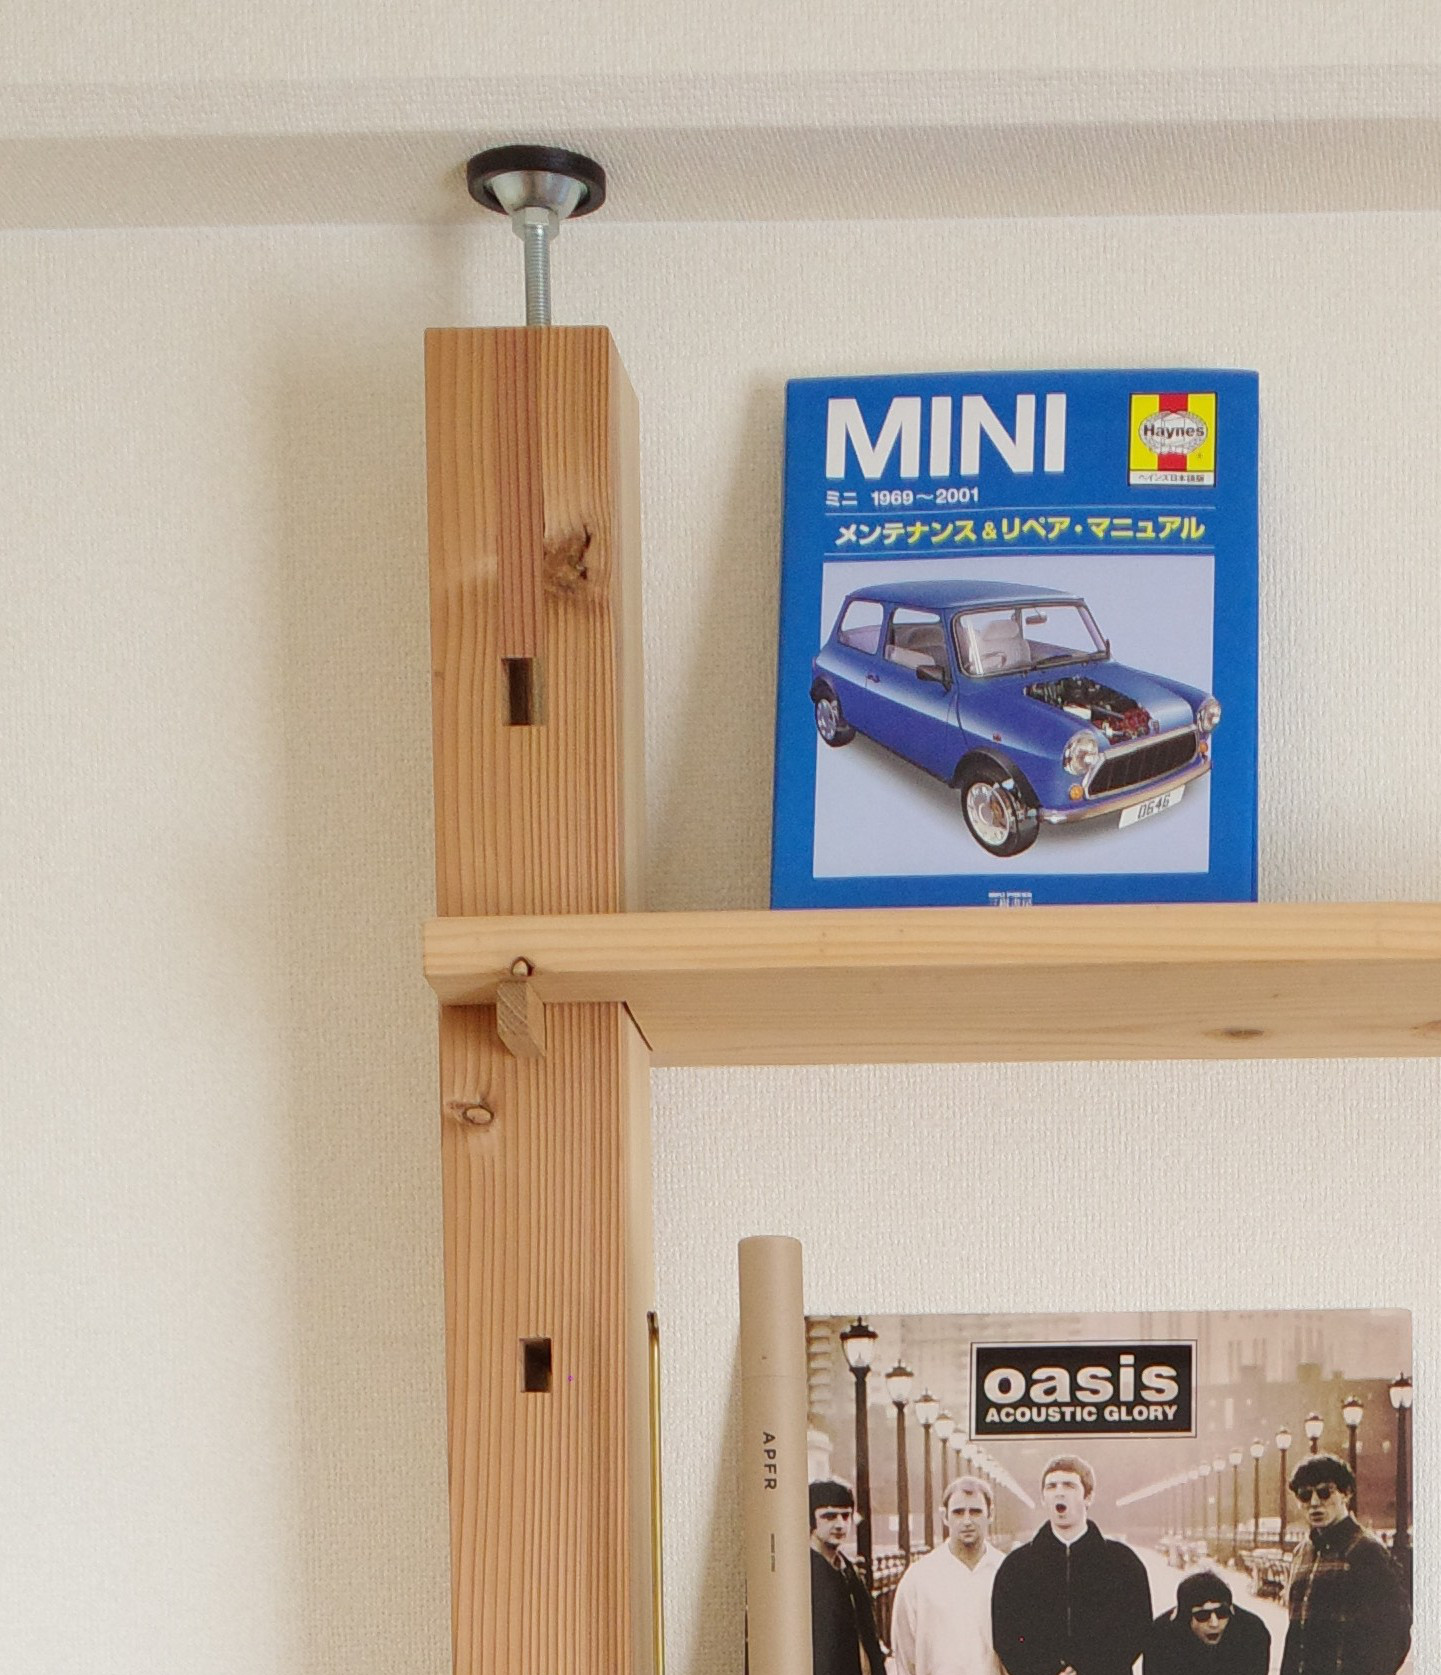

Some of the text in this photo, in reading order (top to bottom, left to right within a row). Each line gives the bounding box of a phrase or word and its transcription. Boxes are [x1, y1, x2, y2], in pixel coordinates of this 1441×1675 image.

[826, 393, 1066, 479] MINI
[1143, 424, 1205, 439] Haynes
[826, 490, 858, 507] ミニ
[983, 1353, 1179, 1404] oasis
[985, 1404, 1178, 1423] ACOUSTIC GLORY
[762, 1430, 777, 1490] APFR
